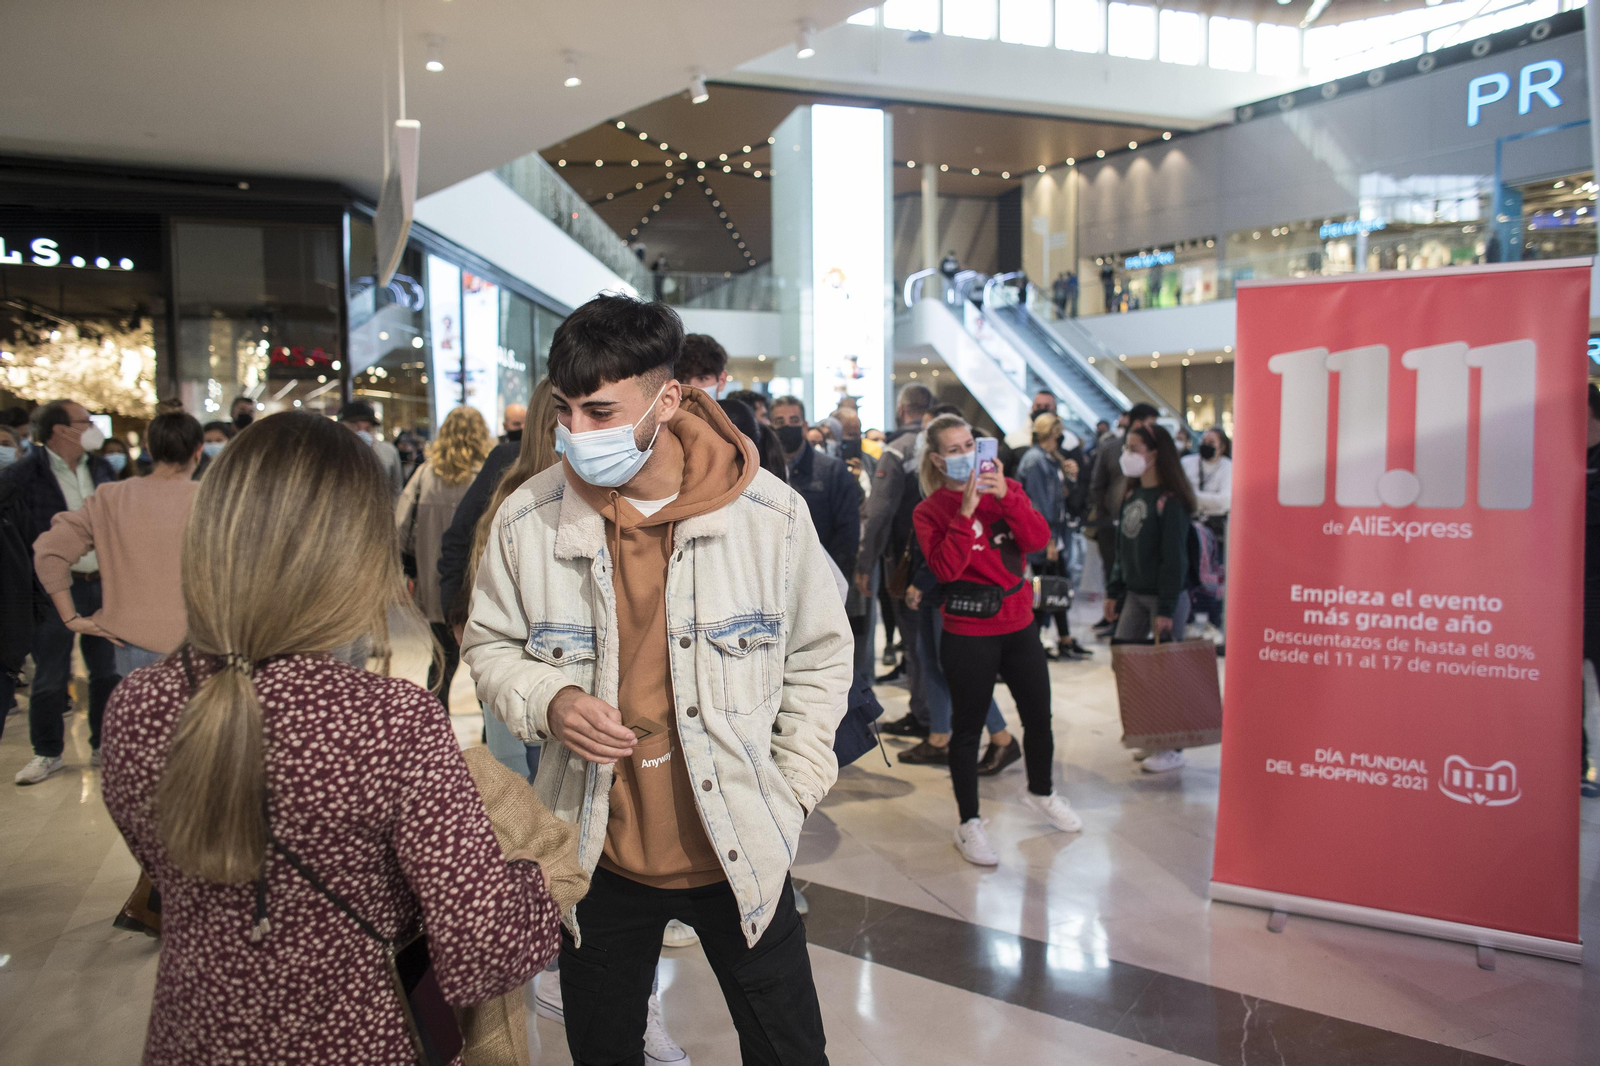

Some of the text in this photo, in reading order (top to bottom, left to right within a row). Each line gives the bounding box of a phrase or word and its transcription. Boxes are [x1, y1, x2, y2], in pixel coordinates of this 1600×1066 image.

[1267, 338, 1537, 510] 11.11
[1322, 515, 1473, 543] de AliExpress
[1290, 584, 1503, 612] Empieza el evento
[1303, 606, 1493, 634] más grande año
[1263, 627, 1535, 660] Descuentazos de hasta el 80%
[1258, 645, 1540, 681] desde el 11 al 17 de noviembre
[641, 751, 672, 768] Anyway
[1315, 747, 1428, 774] DÍA MUNDIAL
[1265, 758, 1428, 791] DEL SHOPPING 2021
